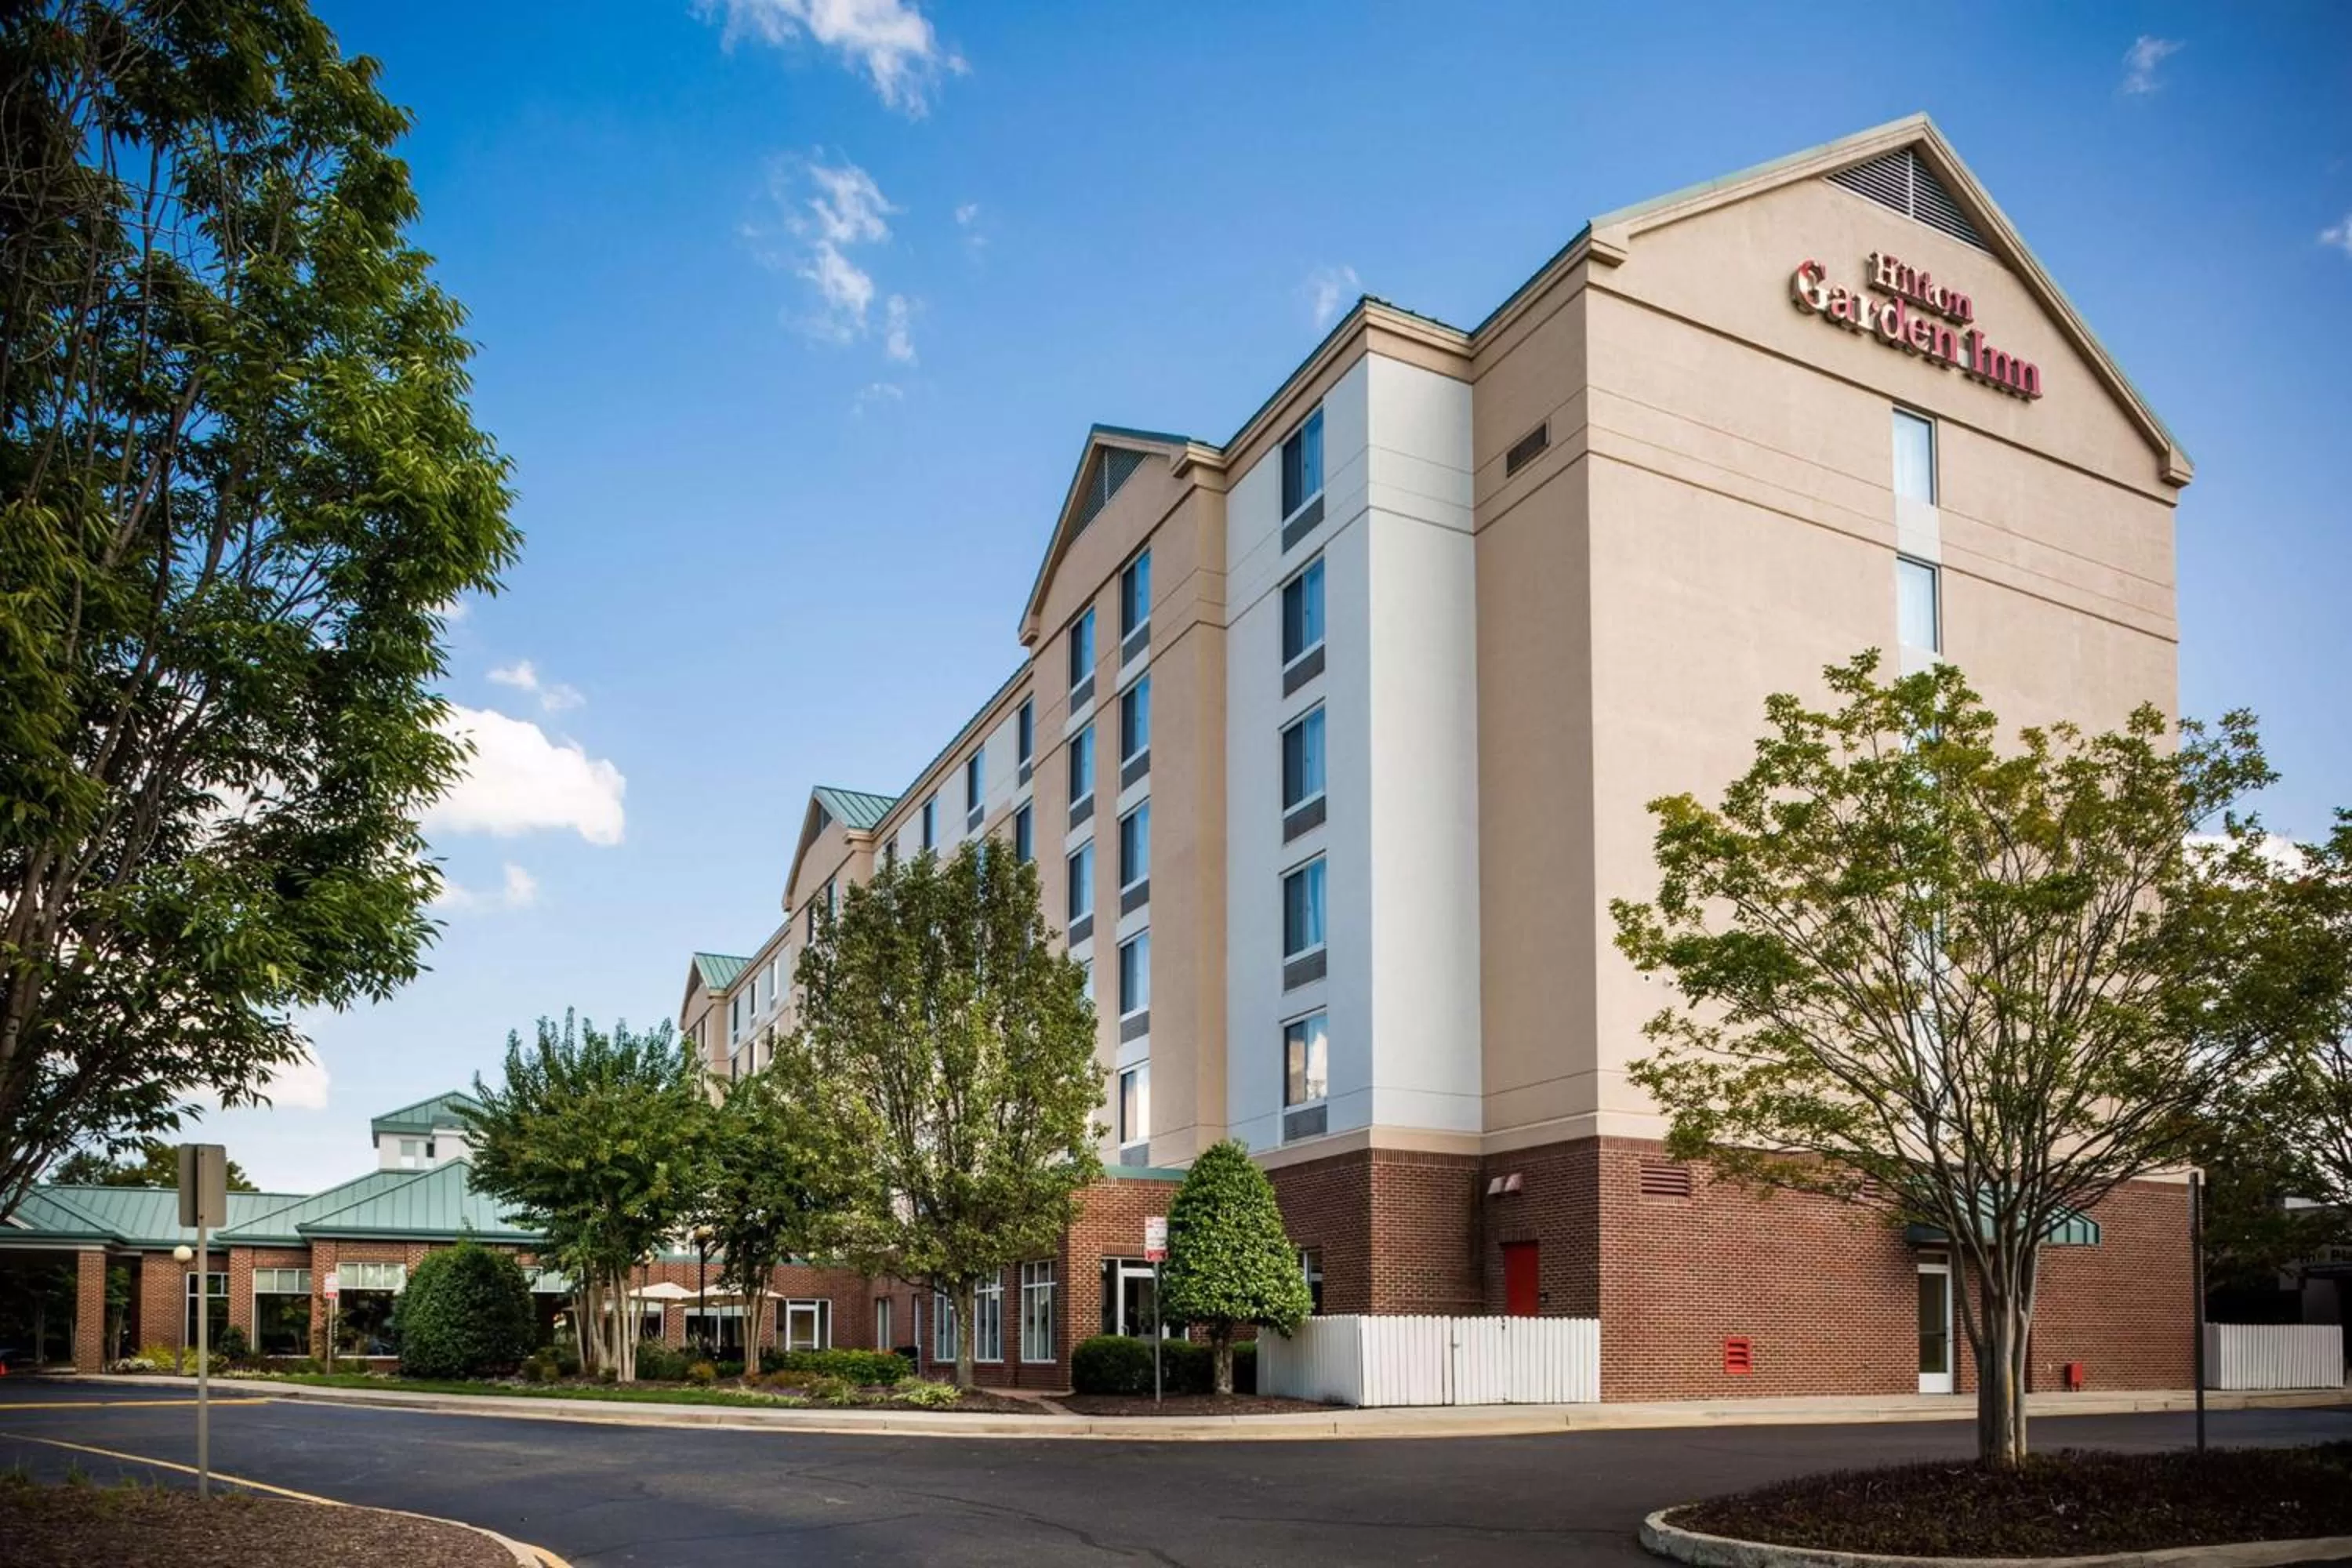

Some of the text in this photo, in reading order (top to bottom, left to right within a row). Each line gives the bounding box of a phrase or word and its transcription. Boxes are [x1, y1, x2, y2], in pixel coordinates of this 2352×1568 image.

[1792, 260, 2042, 400] Garden Inn
[1869, 251, 1973, 324] Hilton
